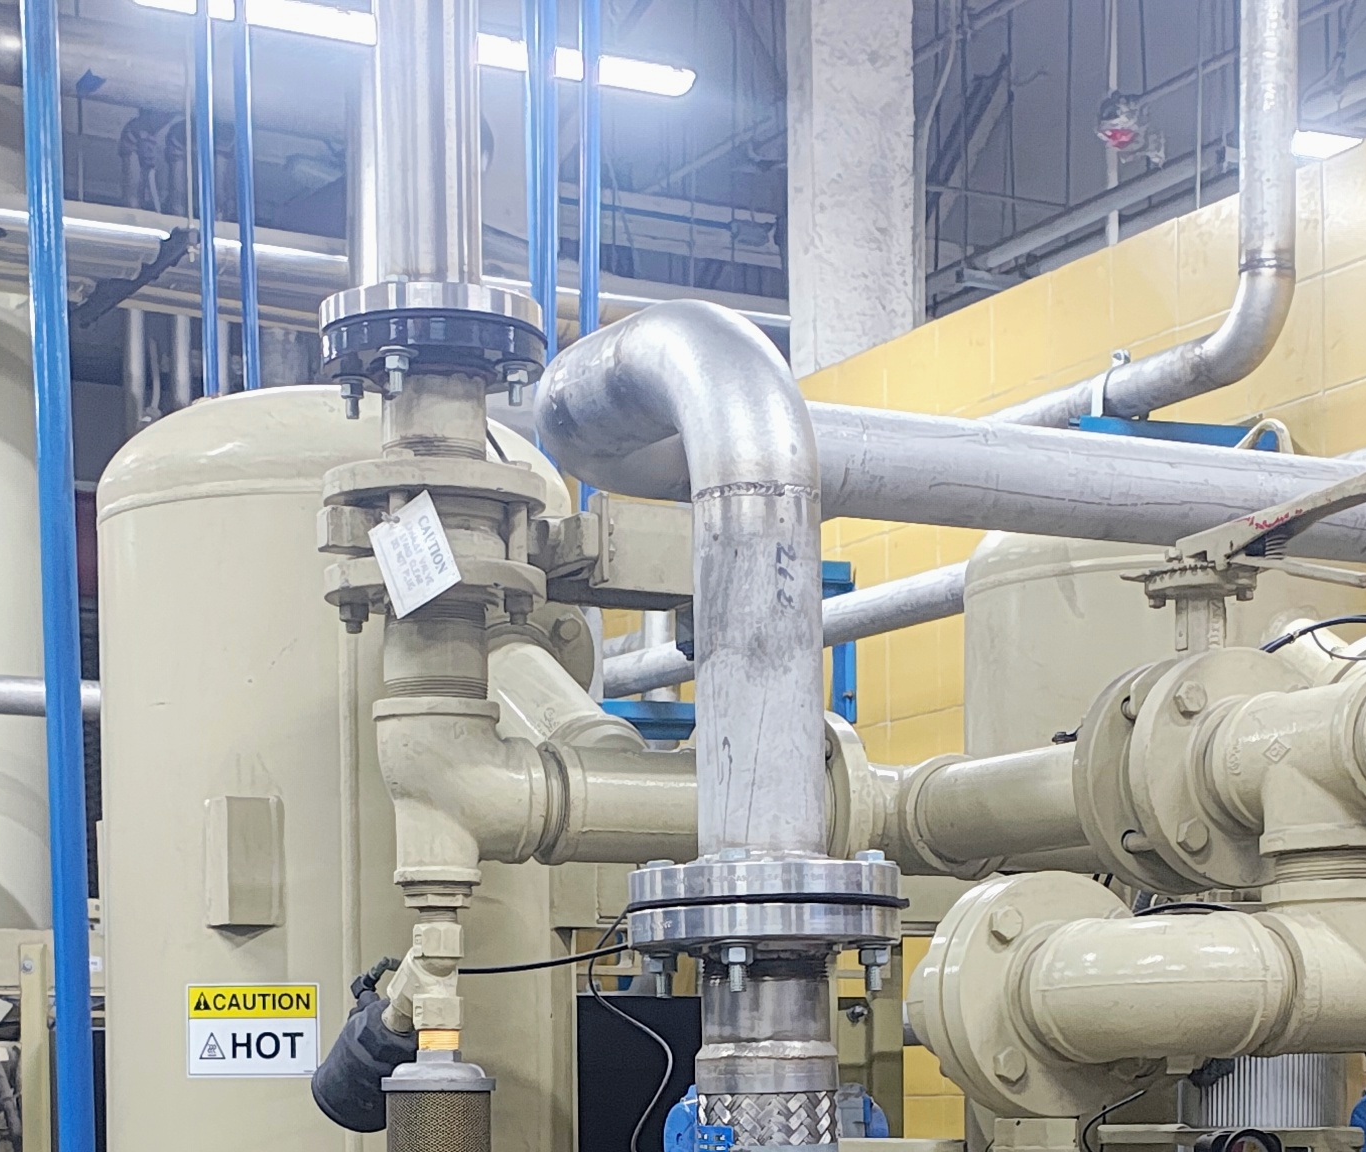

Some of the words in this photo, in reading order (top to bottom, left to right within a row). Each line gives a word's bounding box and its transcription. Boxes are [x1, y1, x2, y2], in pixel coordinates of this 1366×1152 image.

[418, 515, 448, 575] CAUTION
[213, 993, 311, 1011] CAUTION
[231, 1031, 304, 1060] HOT
